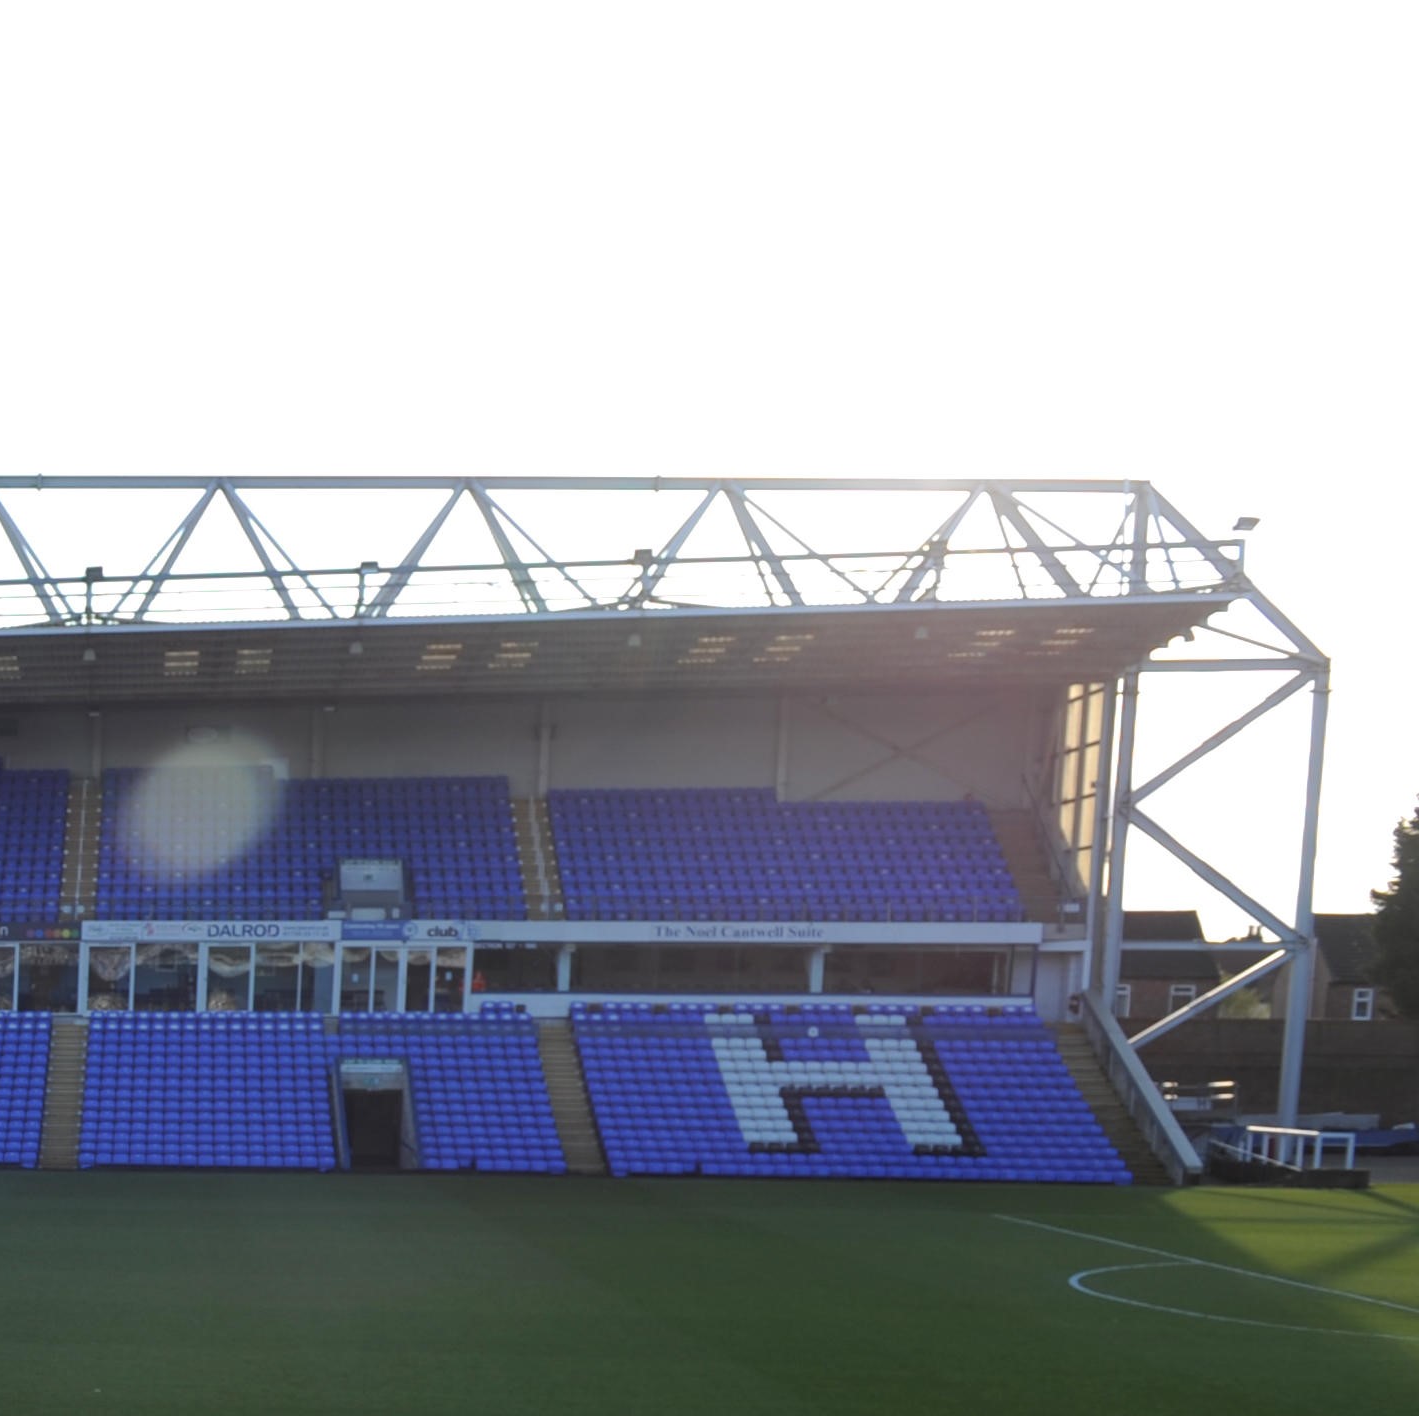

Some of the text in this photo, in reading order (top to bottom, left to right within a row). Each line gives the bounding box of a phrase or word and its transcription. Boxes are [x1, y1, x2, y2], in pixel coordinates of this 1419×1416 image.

[207, 924, 280, 937] DALROD
[426, 925, 458, 937] club
[654, 926, 824, 938] The Noel Cantwell Suite
